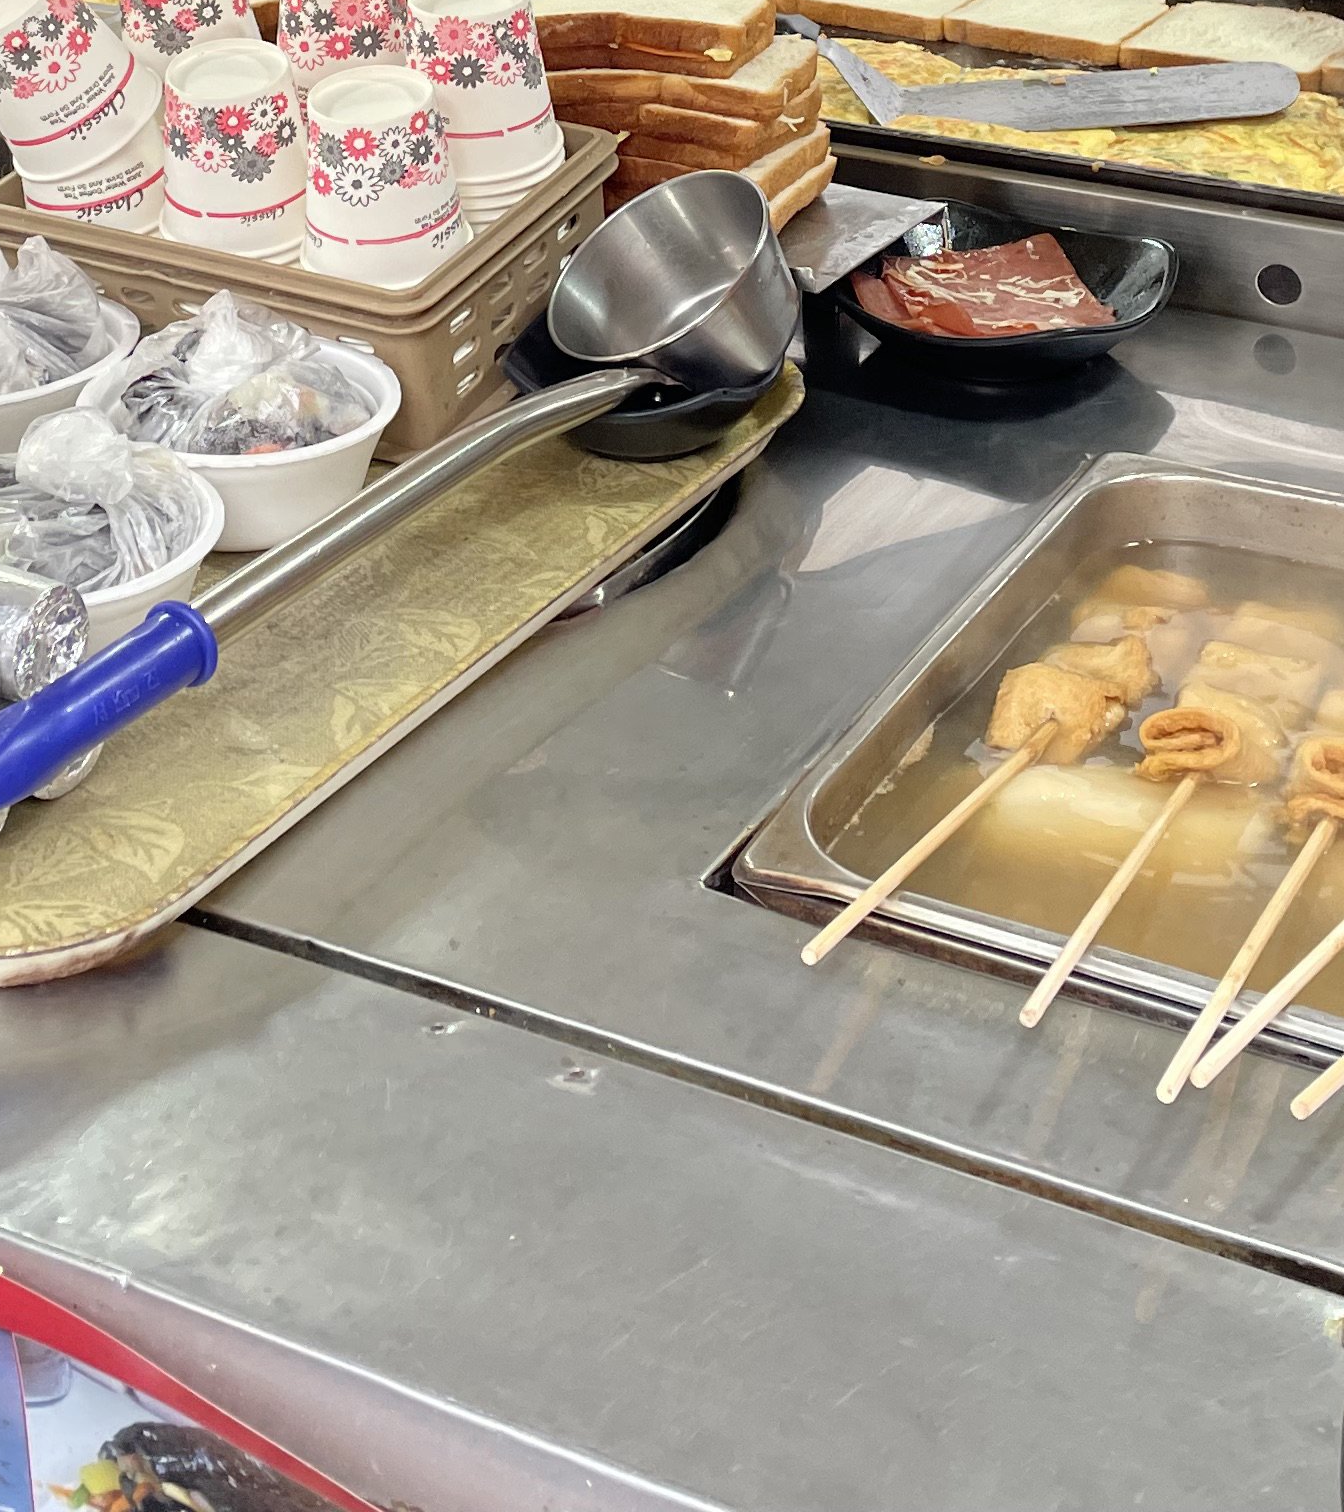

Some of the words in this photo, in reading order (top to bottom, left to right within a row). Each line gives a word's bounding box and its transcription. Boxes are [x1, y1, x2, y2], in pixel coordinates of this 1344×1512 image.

[67, 89, 126, 141] Classic
[76, 188, 145, 224] Classic
[240, 206, 286, 228] Classic
